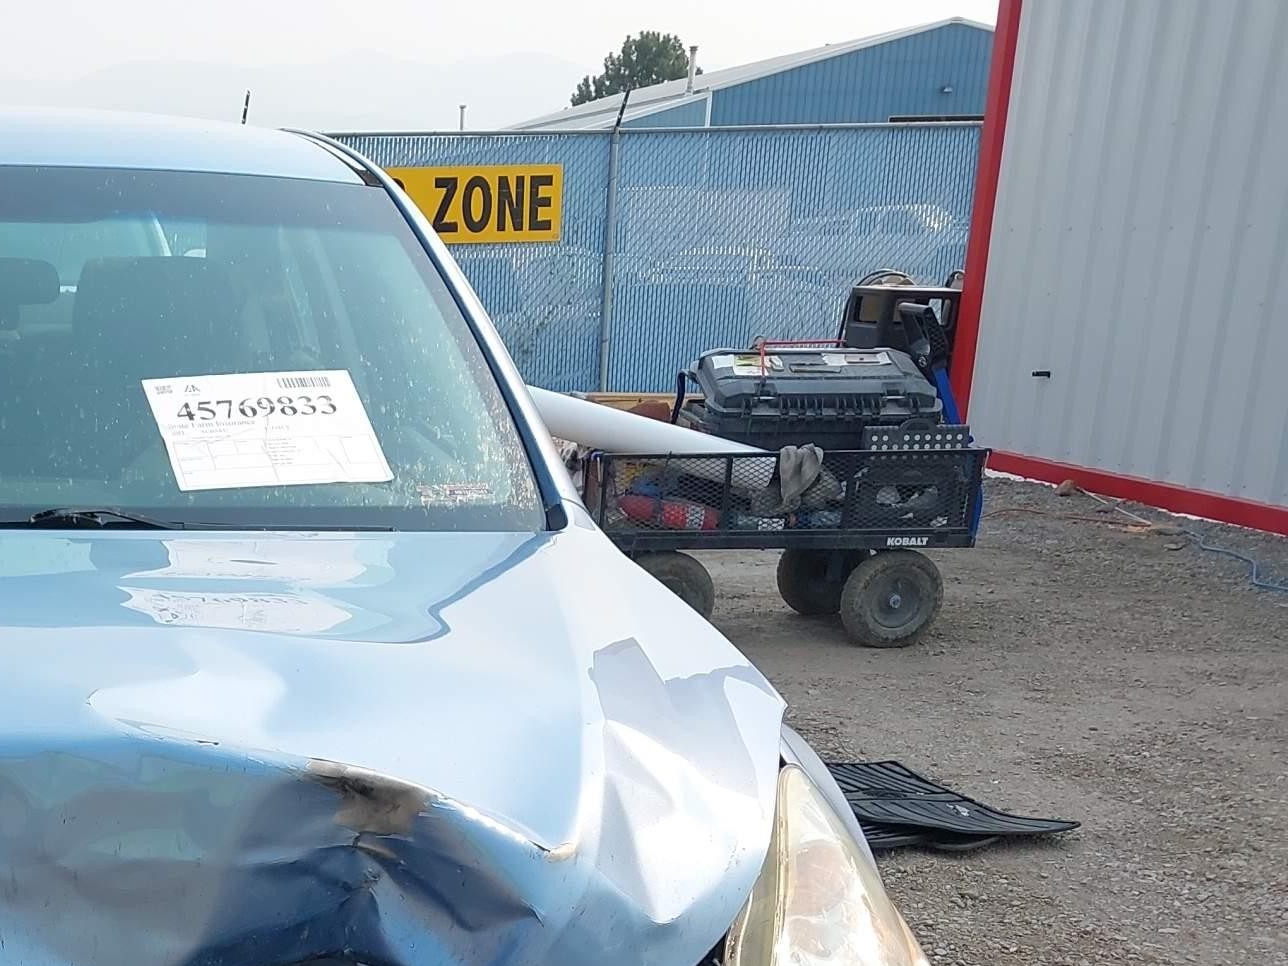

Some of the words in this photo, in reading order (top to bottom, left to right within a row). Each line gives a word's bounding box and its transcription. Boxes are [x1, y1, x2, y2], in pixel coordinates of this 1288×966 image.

[433, 175, 554, 233] ZONE
[176, 395, 337, 421] 45769833
[886, 536, 929, 546] KOBALT
